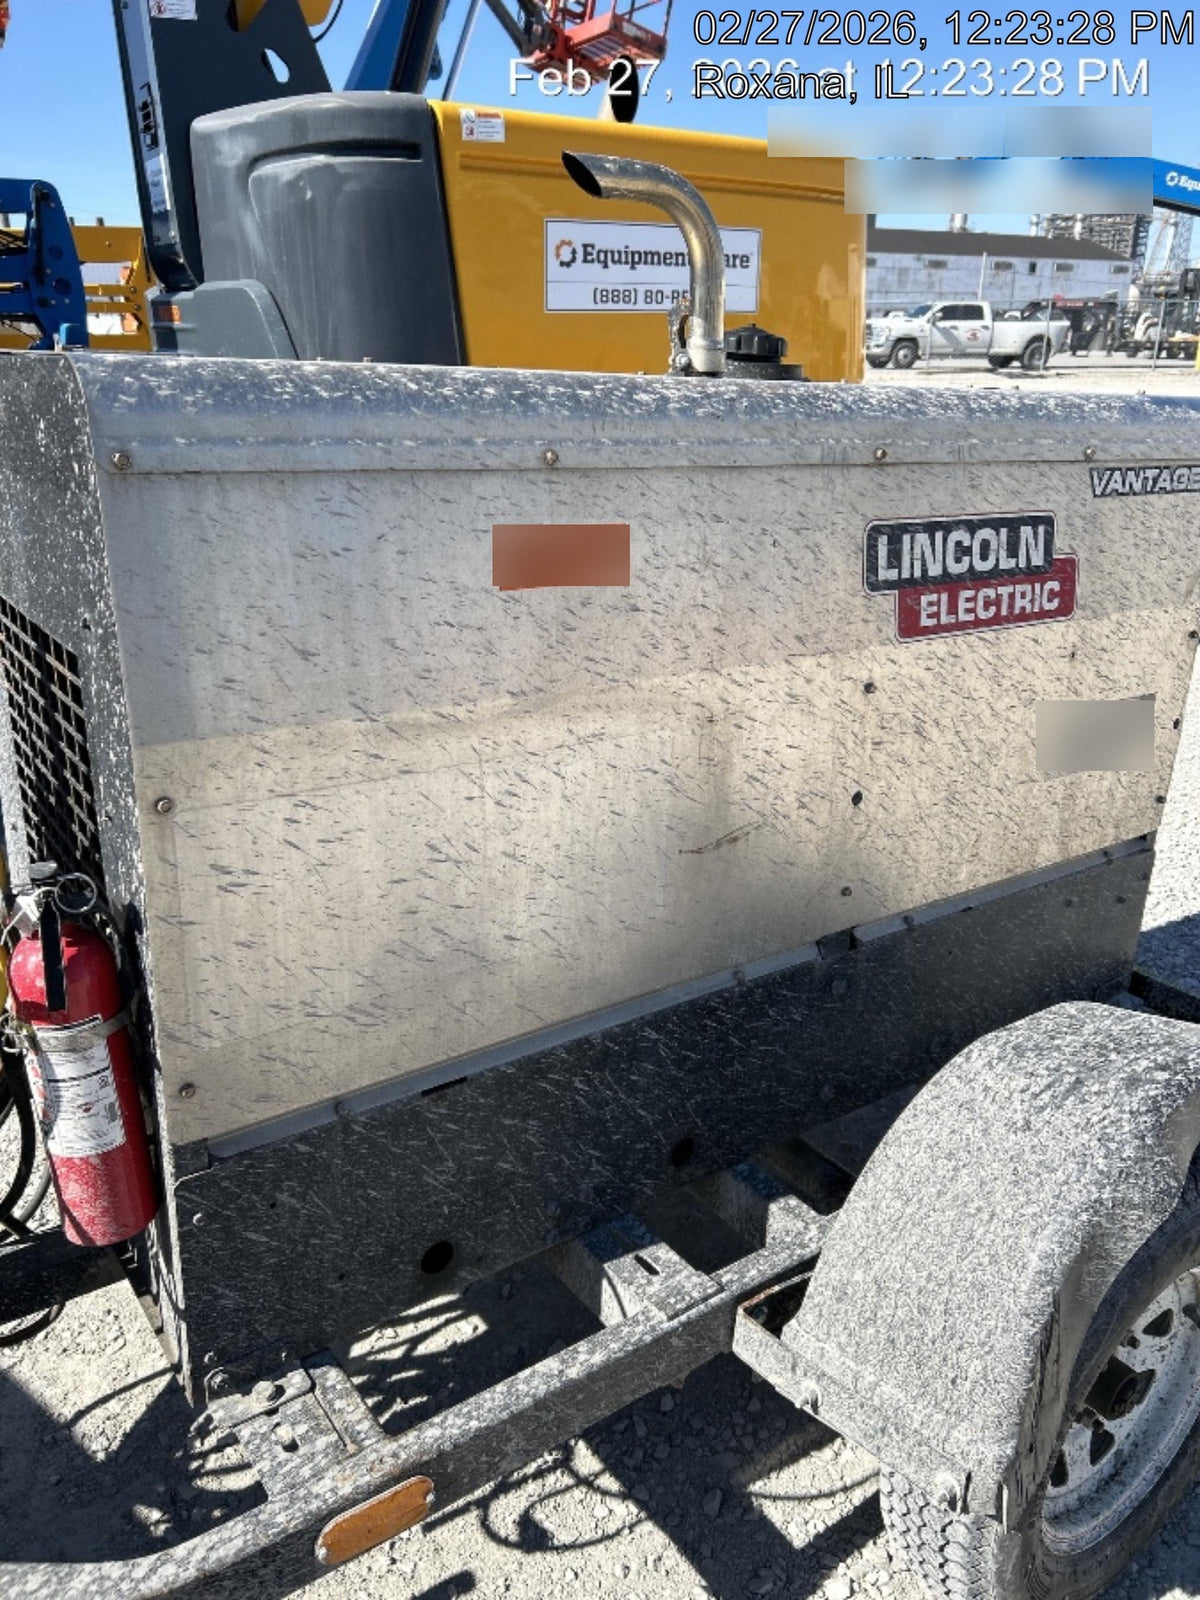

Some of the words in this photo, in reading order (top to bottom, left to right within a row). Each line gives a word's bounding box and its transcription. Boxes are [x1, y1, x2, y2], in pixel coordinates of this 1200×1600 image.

[593, 288, 638, 305] (888)
[1091, 466, 1200, 496] VANTAGE
[877, 524, 1046, 581] LINCOLN
[920, 580, 1061, 627] ELECTRIC
